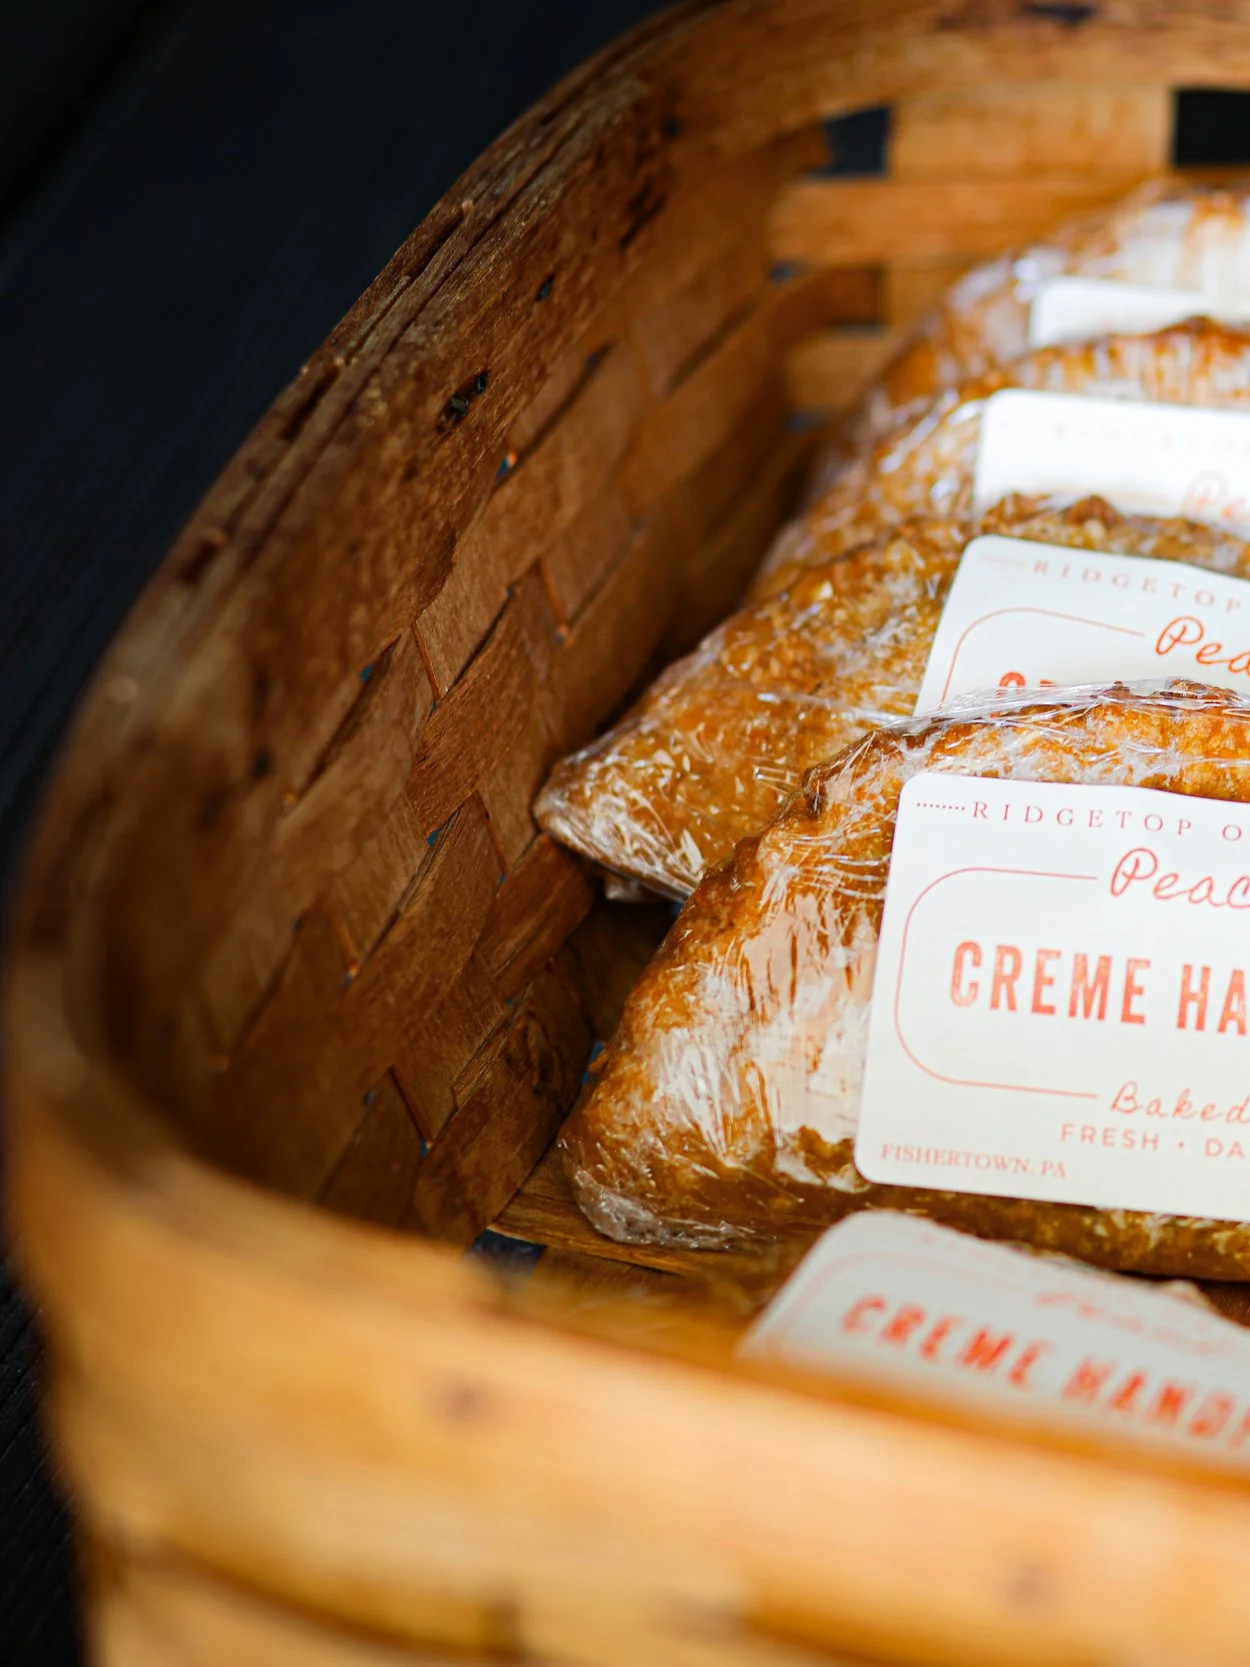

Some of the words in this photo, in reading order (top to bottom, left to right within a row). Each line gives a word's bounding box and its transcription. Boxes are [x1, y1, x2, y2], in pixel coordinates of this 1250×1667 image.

[1033, 561, 1244, 614] RIDGETOP
[971, 800, 1193, 835] RIDGETOP
[949, 939, 1151, 1025] CREME
[1060, 1122, 1160, 1151] FRESH
[1040, 1160, 1068, 1180] PA
[841, 1292, 1049, 1388] CREME
